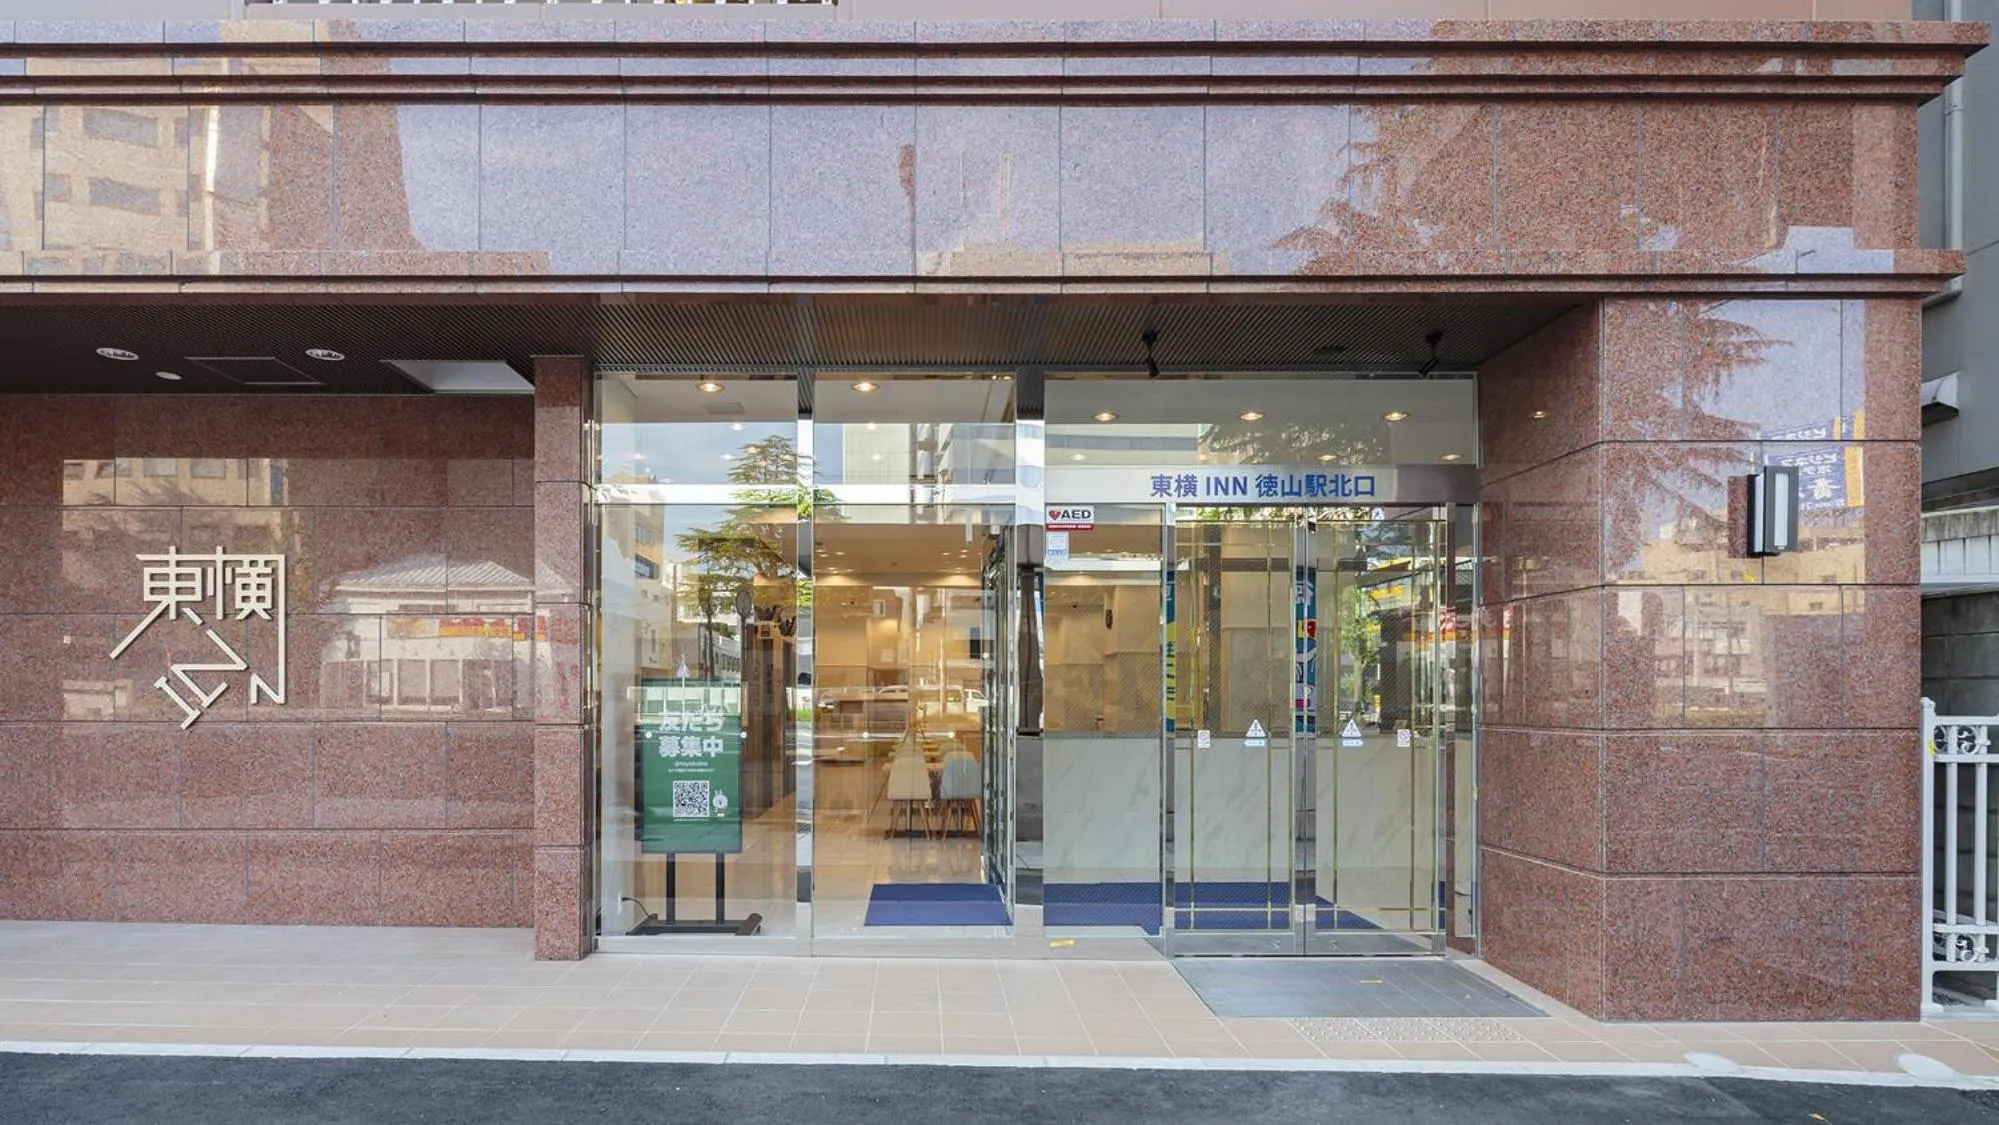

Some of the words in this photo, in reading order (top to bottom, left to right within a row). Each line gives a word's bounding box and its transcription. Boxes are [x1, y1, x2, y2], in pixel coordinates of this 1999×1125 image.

[1150, 474, 1198, 497] 東横
[1206, 476, 1248, 496] INN
[1255, 474, 1375, 497] 徳山駅北口
[1061, 509, 1091, 519] AED
[659, 735, 724, 757] 募集中
